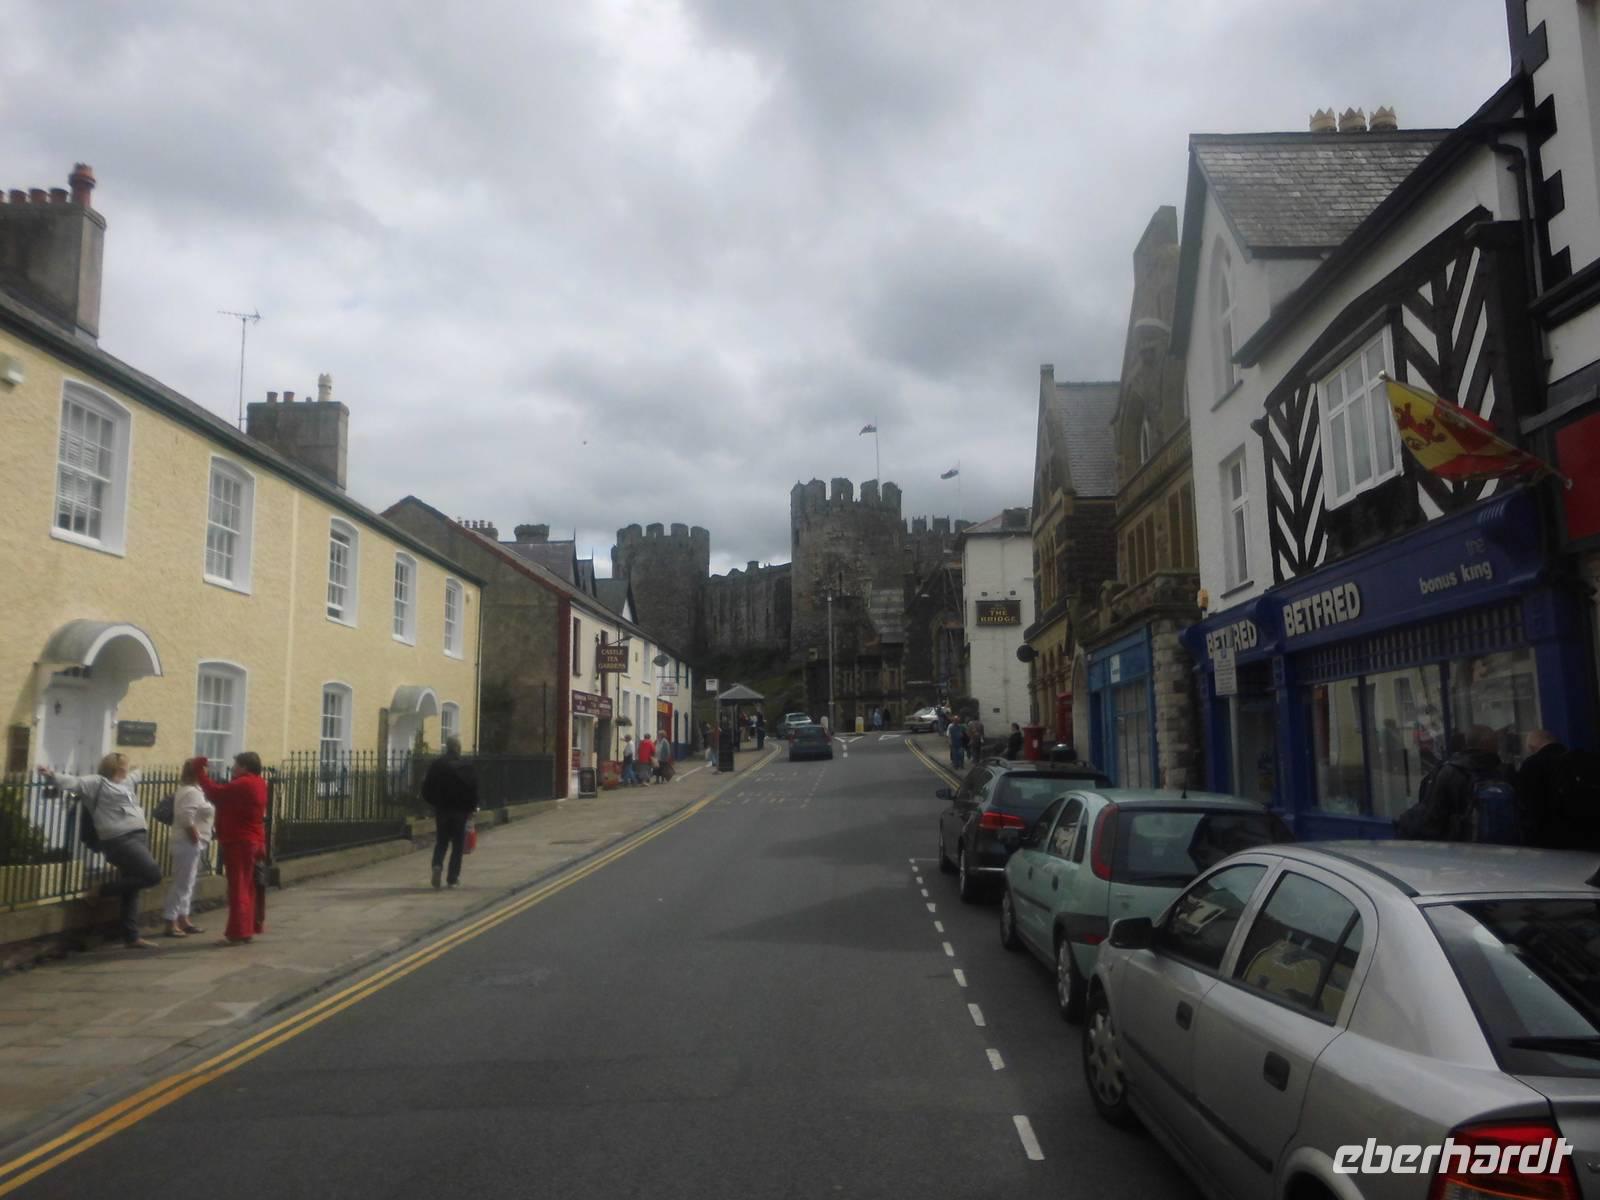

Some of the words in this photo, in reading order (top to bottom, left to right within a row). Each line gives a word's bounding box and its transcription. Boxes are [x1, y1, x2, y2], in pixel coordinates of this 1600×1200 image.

[1419, 572, 1458, 595] bonus
[1461, 559, 1493, 582] king
[1282, 581, 1361, 638] BETFRED
[1206, 619, 1258, 660] BETRED
